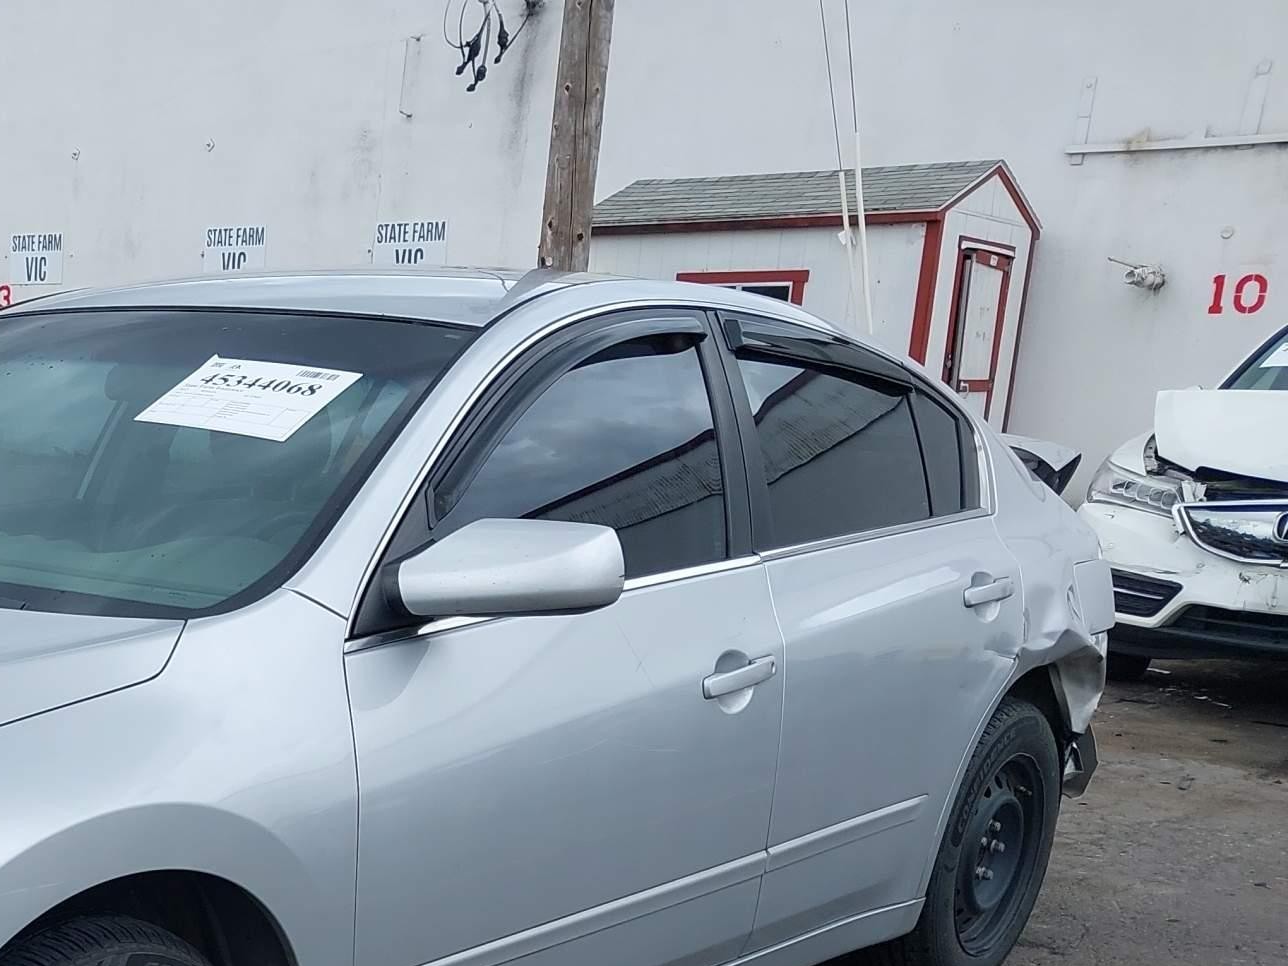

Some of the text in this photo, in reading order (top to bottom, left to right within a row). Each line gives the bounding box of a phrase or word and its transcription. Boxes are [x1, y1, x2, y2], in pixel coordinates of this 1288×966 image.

[12, 234, 62, 252] STATE FARM
[206, 227, 265, 247] STATE FARM
[377, 221, 446, 244] STATE FARM
[25, 256, 47, 282] VIC
[1208, 274, 1268, 314] 10
[200, 373, 323, 397] 45344068
